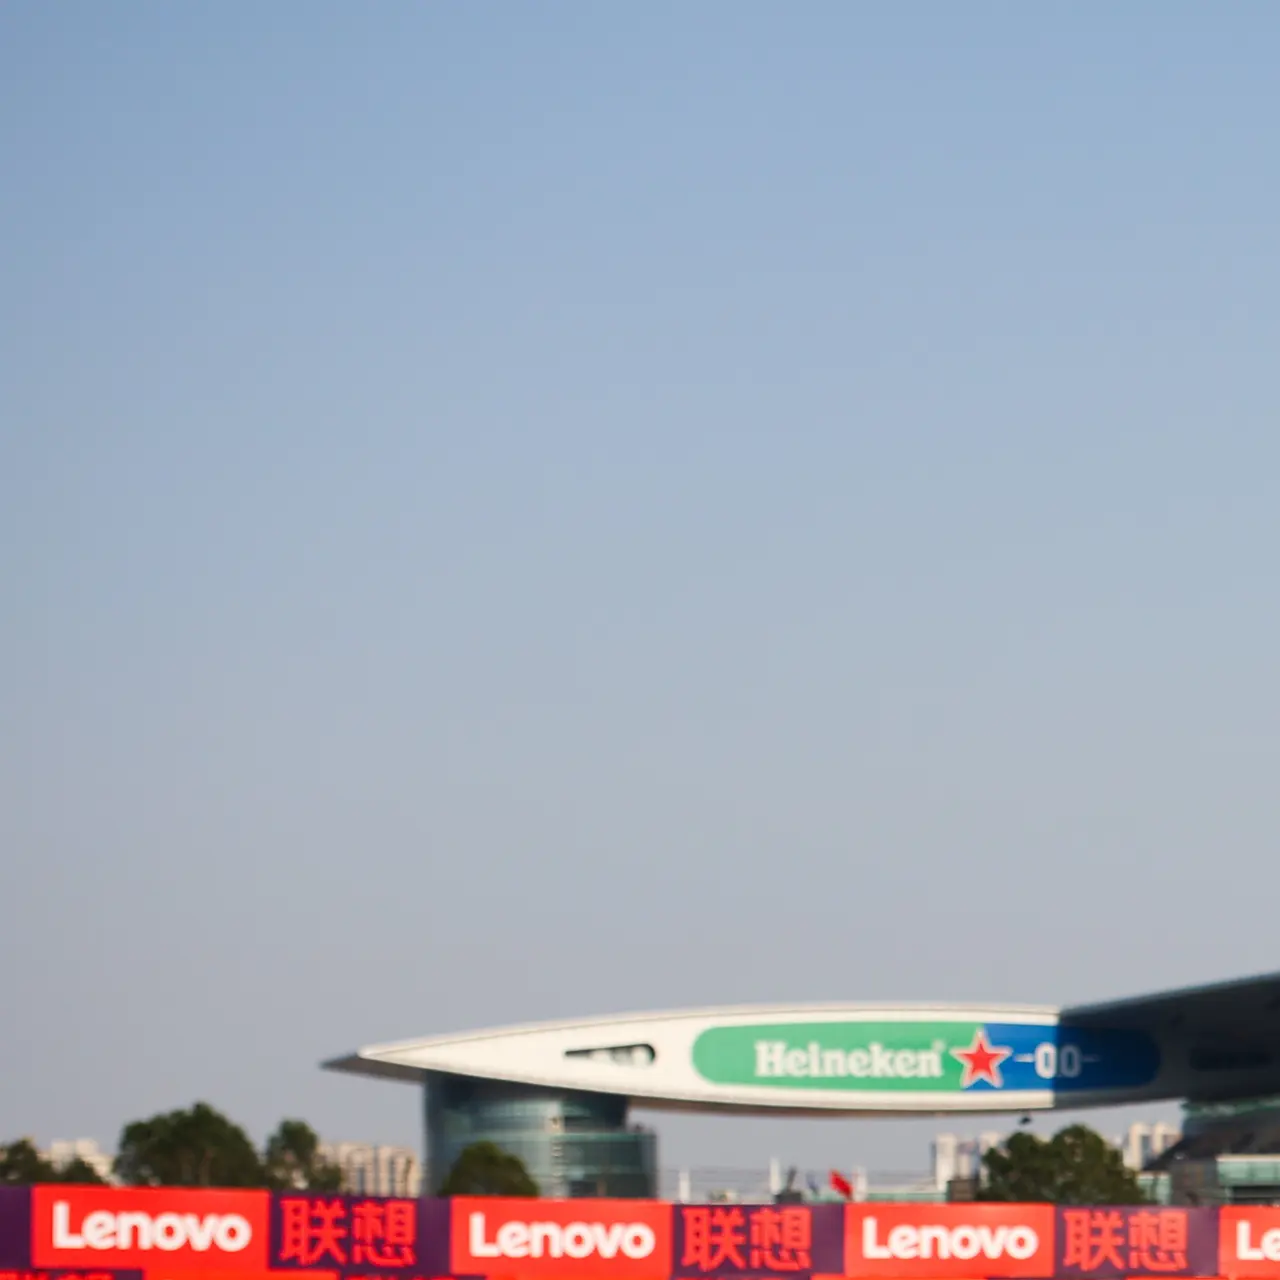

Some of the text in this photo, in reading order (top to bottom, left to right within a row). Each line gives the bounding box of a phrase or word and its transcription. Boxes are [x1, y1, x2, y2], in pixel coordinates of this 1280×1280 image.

[755, 1041, 944, 1079] Heineken
[53, 1202, 252, 1252] Lenovo
[280, 1197, 417, 1267] 联想
[469, 1212, 656, 1259] Lenovo
[682, 1207, 811, 1271] 联想
[862, 1216, 1039, 1260] Lenovo
[1063, 1208, 1189, 1271] 联想
